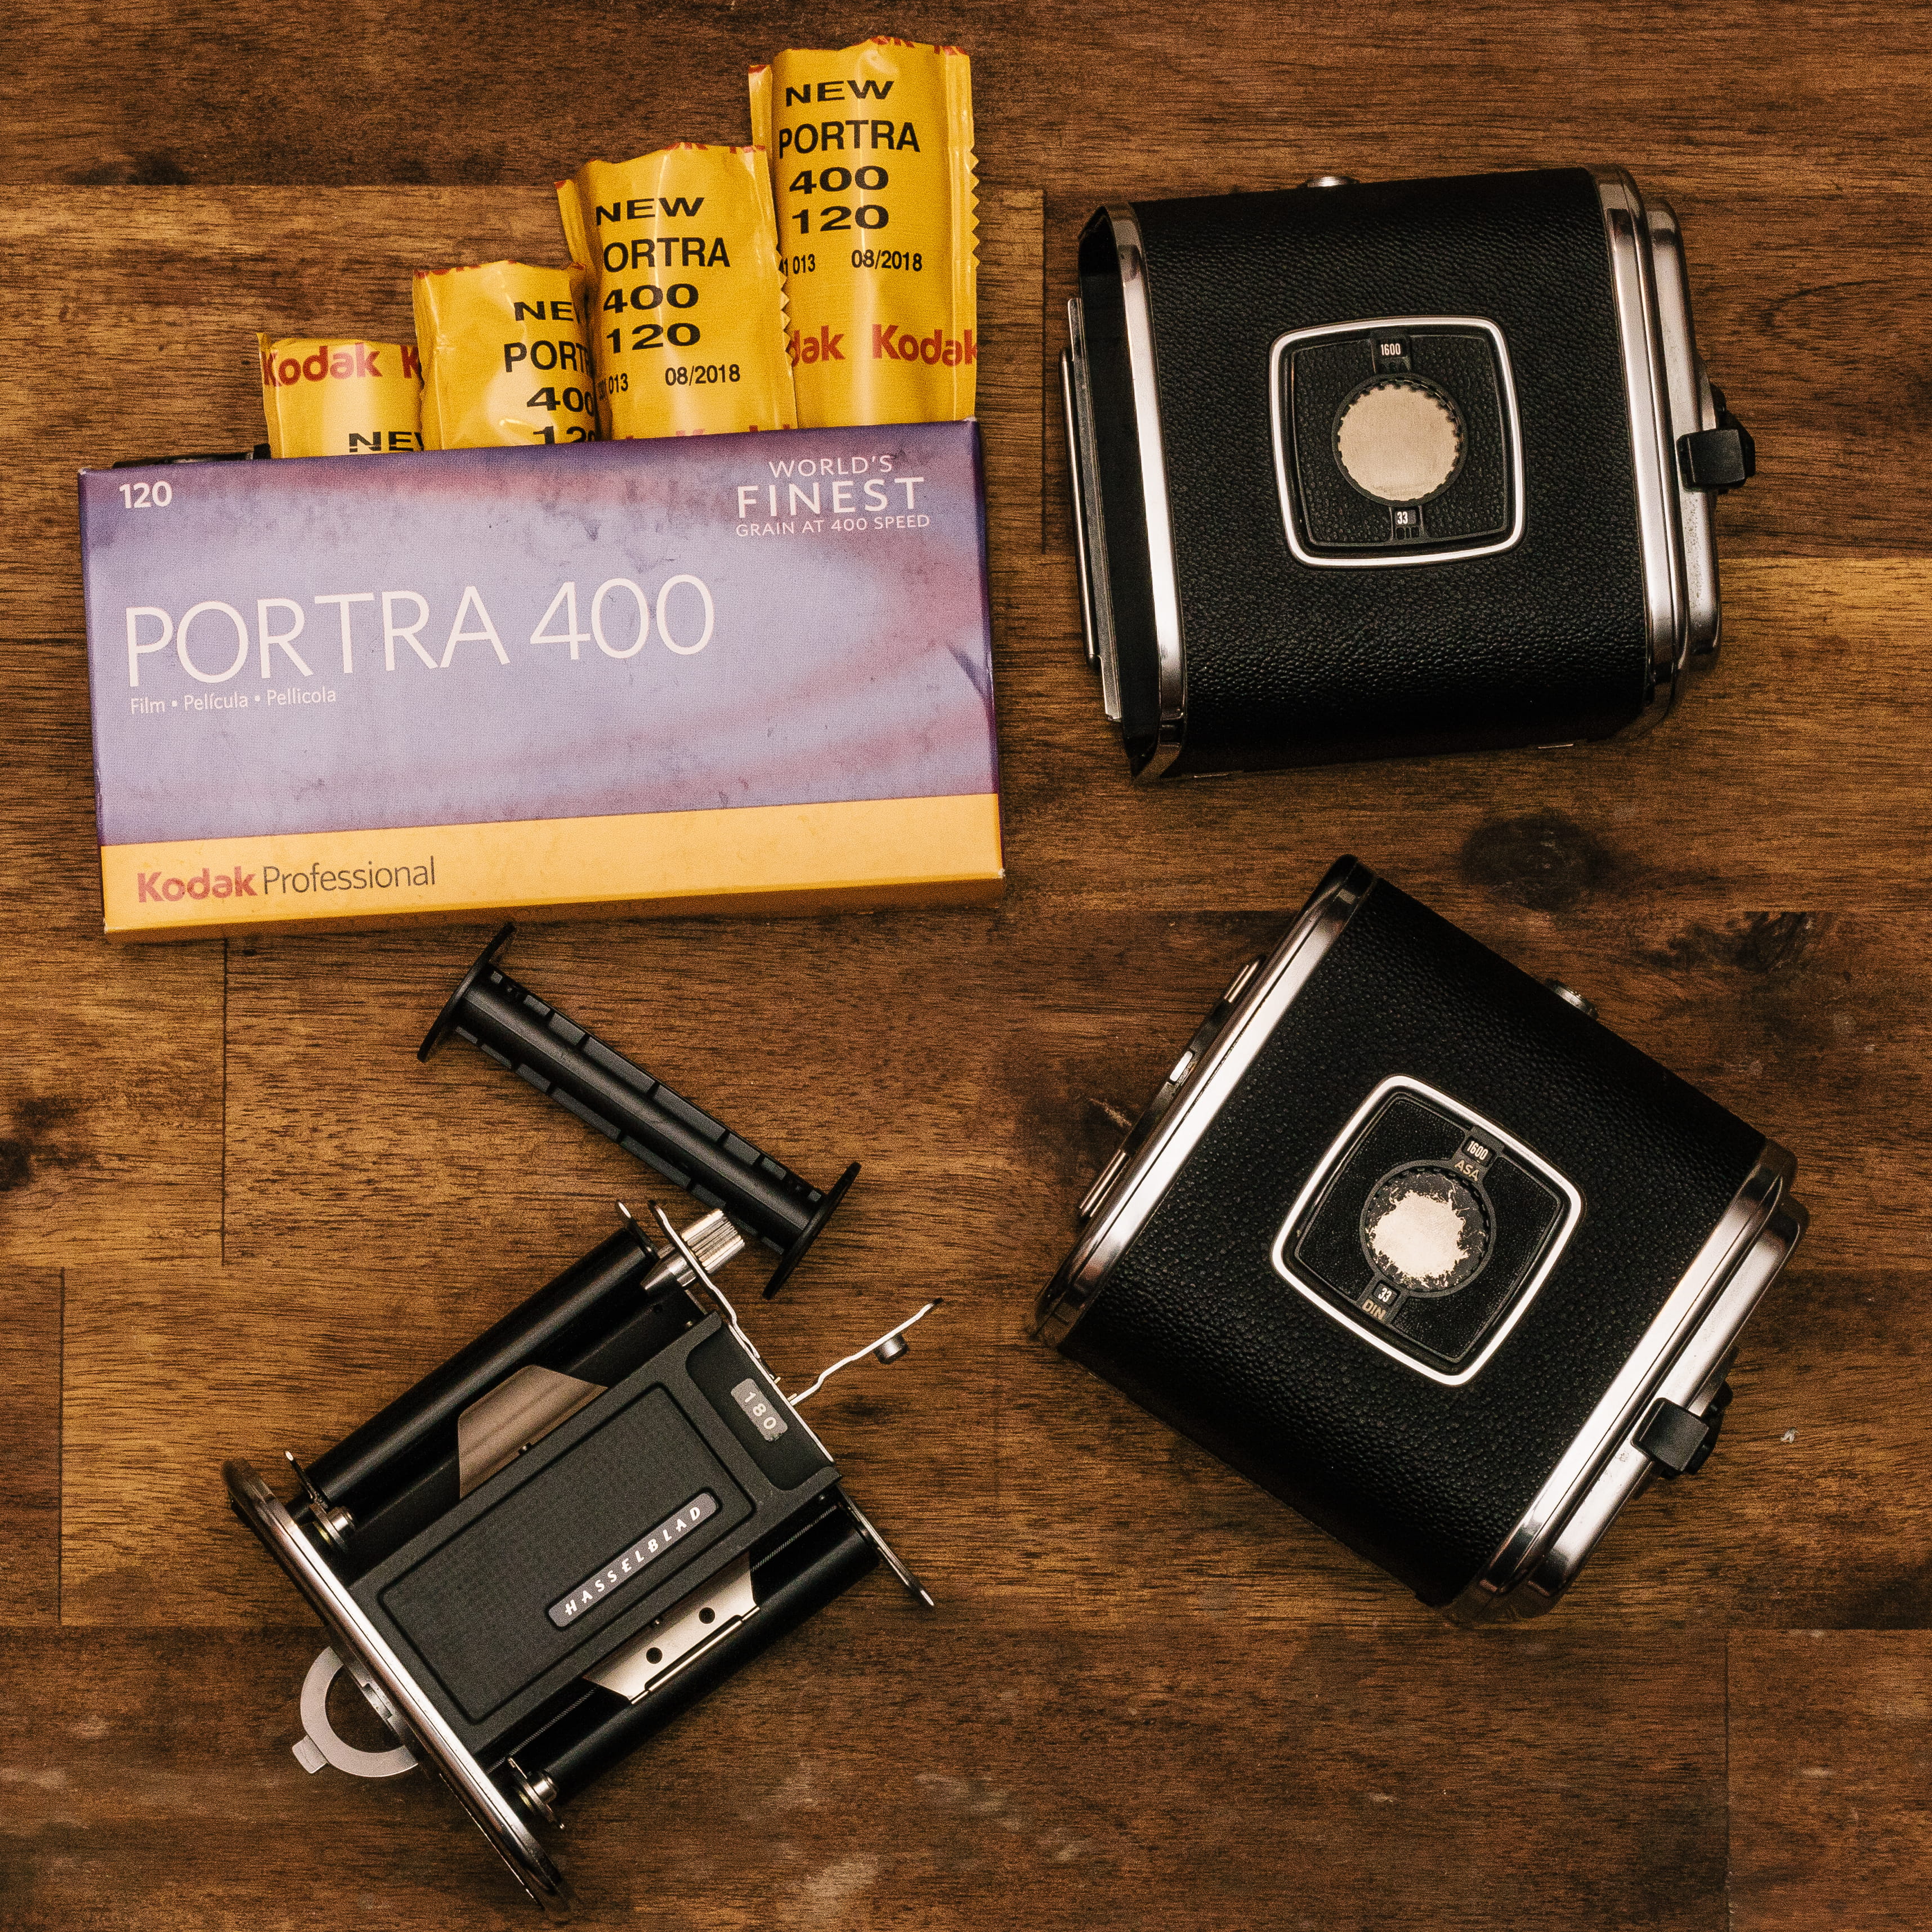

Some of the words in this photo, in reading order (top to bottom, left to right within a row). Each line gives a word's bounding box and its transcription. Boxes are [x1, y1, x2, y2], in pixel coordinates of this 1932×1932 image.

[786, 80, 894, 106] NEW
[780, 120, 920, 159] PORTRA
[789, 166, 889, 194] 400
[596, 197, 704, 225] NEW
[792, 204, 889, 234] 120
[851, 249, 922, 271] 08/2018
[603, 283, 699, 314] 400
[513, 301, 581, 324] NE
[607, 323, 700, 354] 120
[1380, 343, 1401, 356] 1600
[261, 342, 383, 387] Kodak
[665, 364, 741, 386] 08/2018
[769, 455, 893, 478] WORLD'S
[119, 481, 173, 508] 120
[737, 477, 924, 518] FINEST
[736, 523, 795, 536] GRAIN
[802, 520, 824, 533] AT
[831, 518, 867, 531] 400
[874, 515, 930, 530] SPEED
[1397, 511, 1408, 525] 33
[126, 586, 510, 687] PORTRA
[530, 574, 714, 660] 400
[130, 697, 166, 714] Film
[184, 692, 249, 712] Película
[267, 686, 337, 706] Pellicola
[137, 866, 258, 903] Kodak
[263, 856, 436, 895] Professional
[1467, 1141, 1488, 1160] 1600
[1454, 1160, 1479, 1181] ASA
[1378, 1287, 1392, 1303] 33
[1362, 1299, 1386, 1320] DIN
[744, 1390, 777, 1430] 180
[565, 1506, 701, 1616] HASSELBLAD
